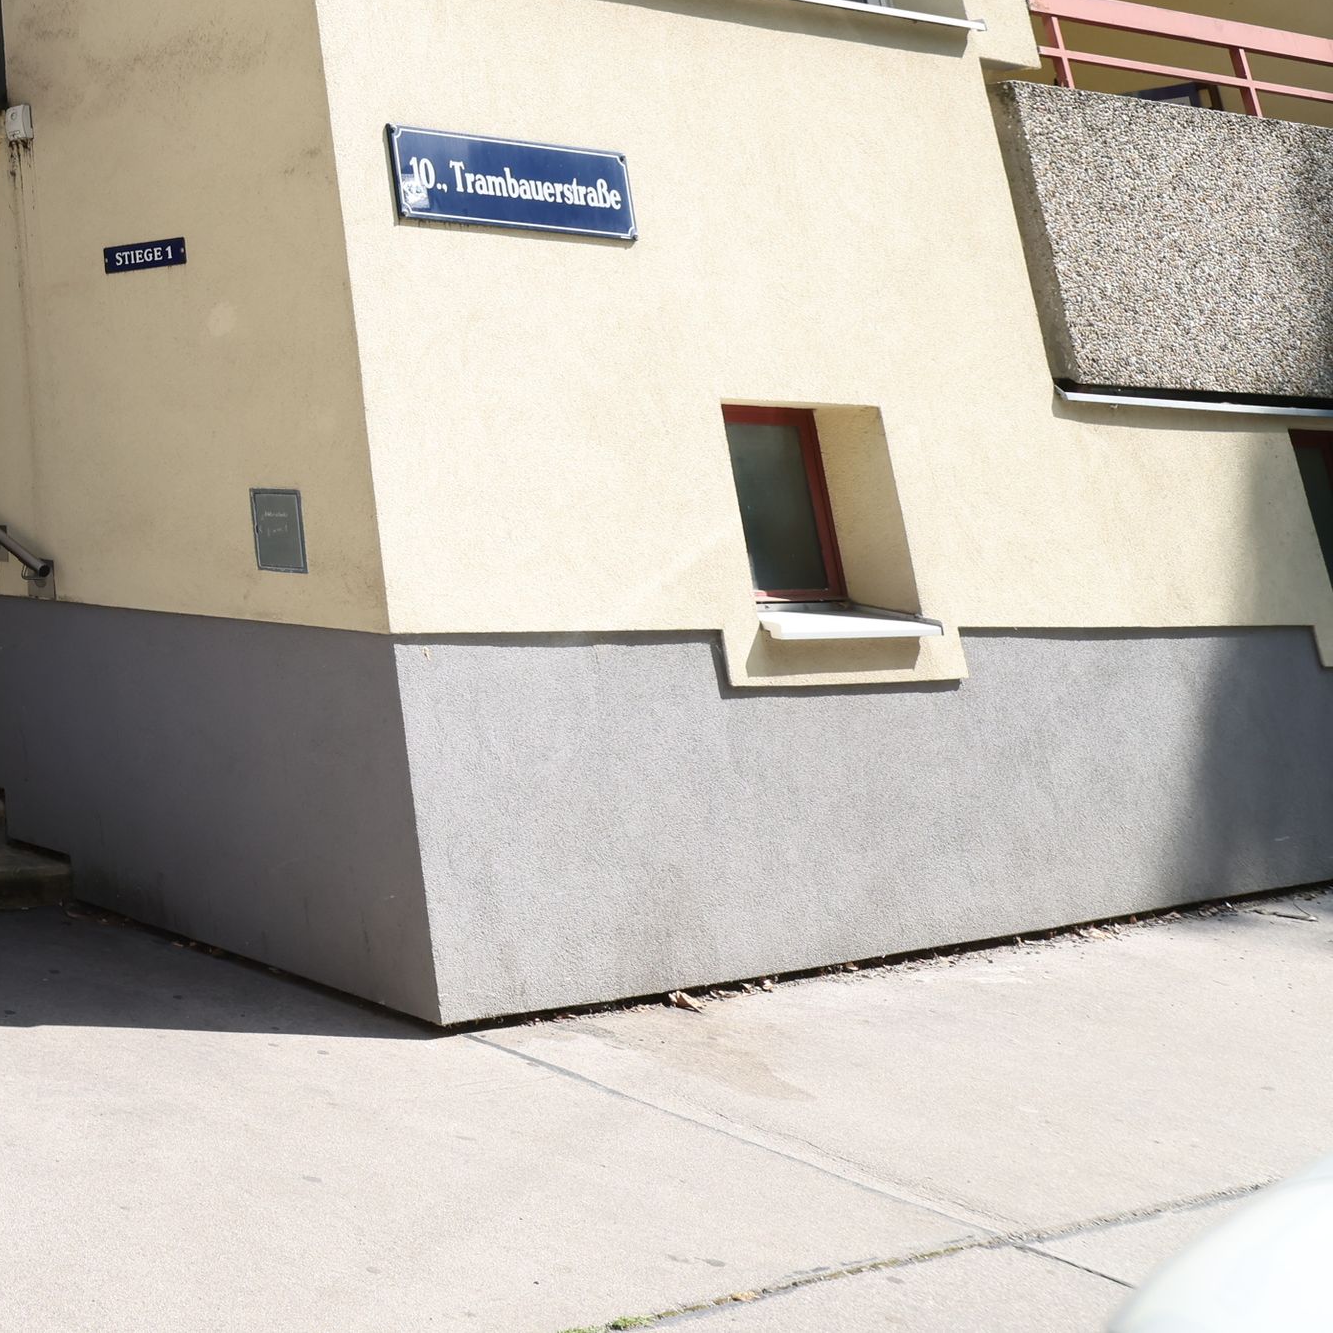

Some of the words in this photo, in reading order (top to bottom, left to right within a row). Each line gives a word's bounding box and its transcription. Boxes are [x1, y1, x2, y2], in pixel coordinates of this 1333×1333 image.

[409, 156, 448, 193] 10.,
[449, 160, 622, 210] Trambauerstraße
[115, 247, 163, 266] STIEGE
[165, 245, 173, 259] 1
